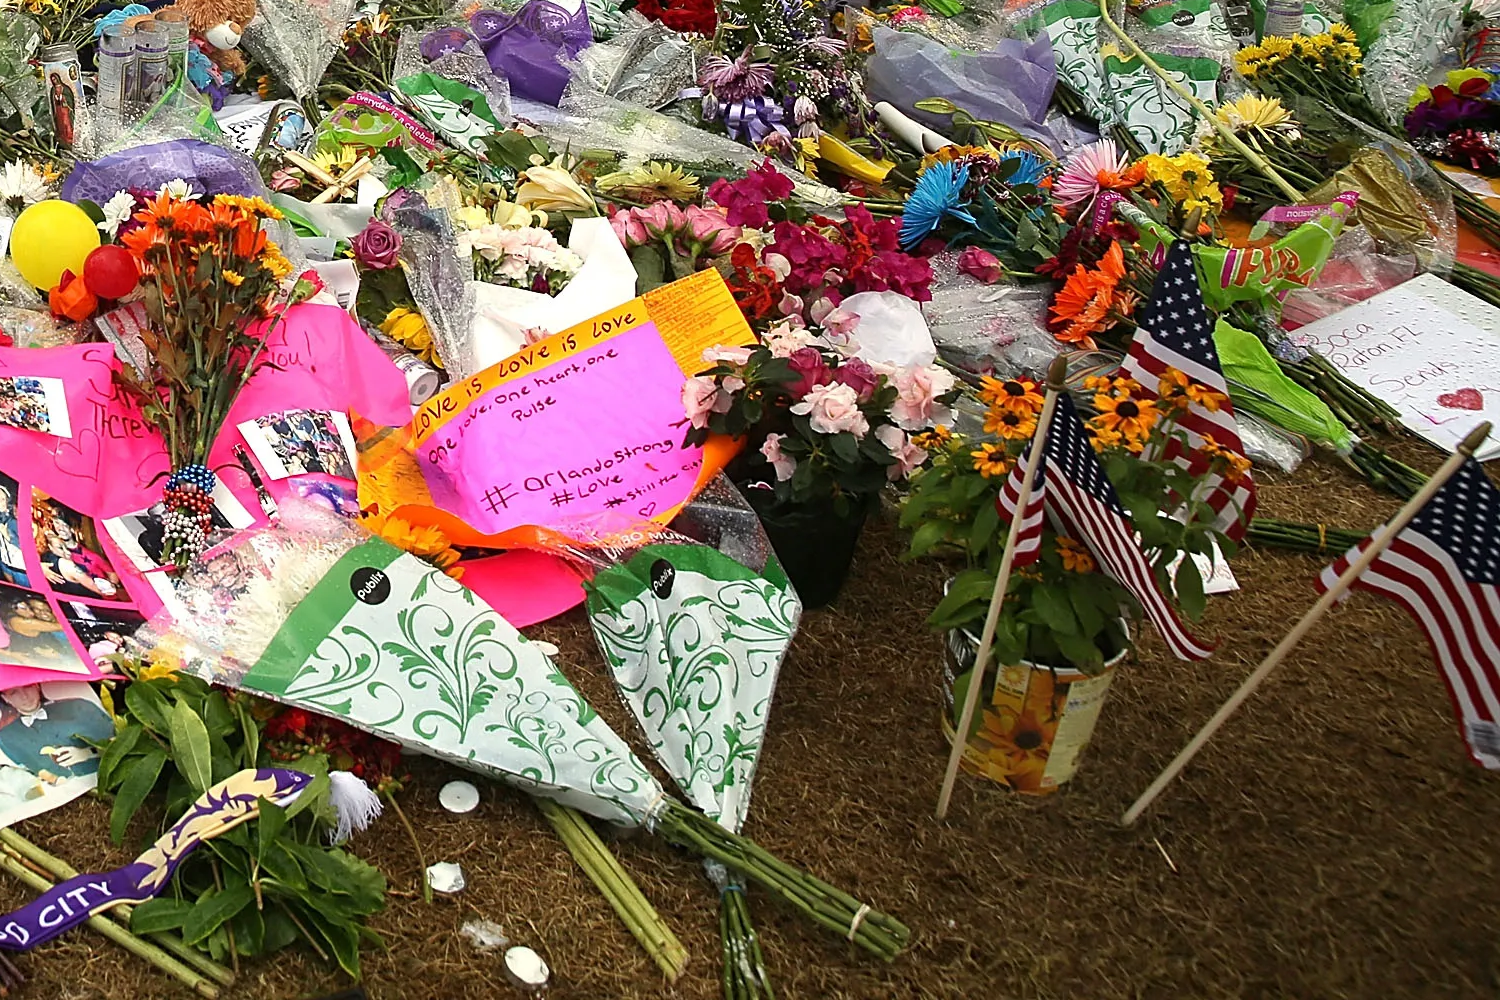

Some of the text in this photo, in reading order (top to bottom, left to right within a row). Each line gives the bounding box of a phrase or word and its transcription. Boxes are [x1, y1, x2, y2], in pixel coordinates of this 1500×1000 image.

[356, 93, 390, 114] Everyday
[391, 108, 399, 120] is
[1388, 325, 1425, 345] FL
[466, 377, 483, 398] is
[561, 332, 578, 353] is
[587, 348, 620, 367] one
[1369, 361, 1461, 393] Sends
[511, 395, 557, 422] Pulse
[602, 531, 643, 561] UMBO
[357, 571, 385, 601] Publix
[653, 567, 674, 592] Publix
[38, 881, 113, 929] CITY
